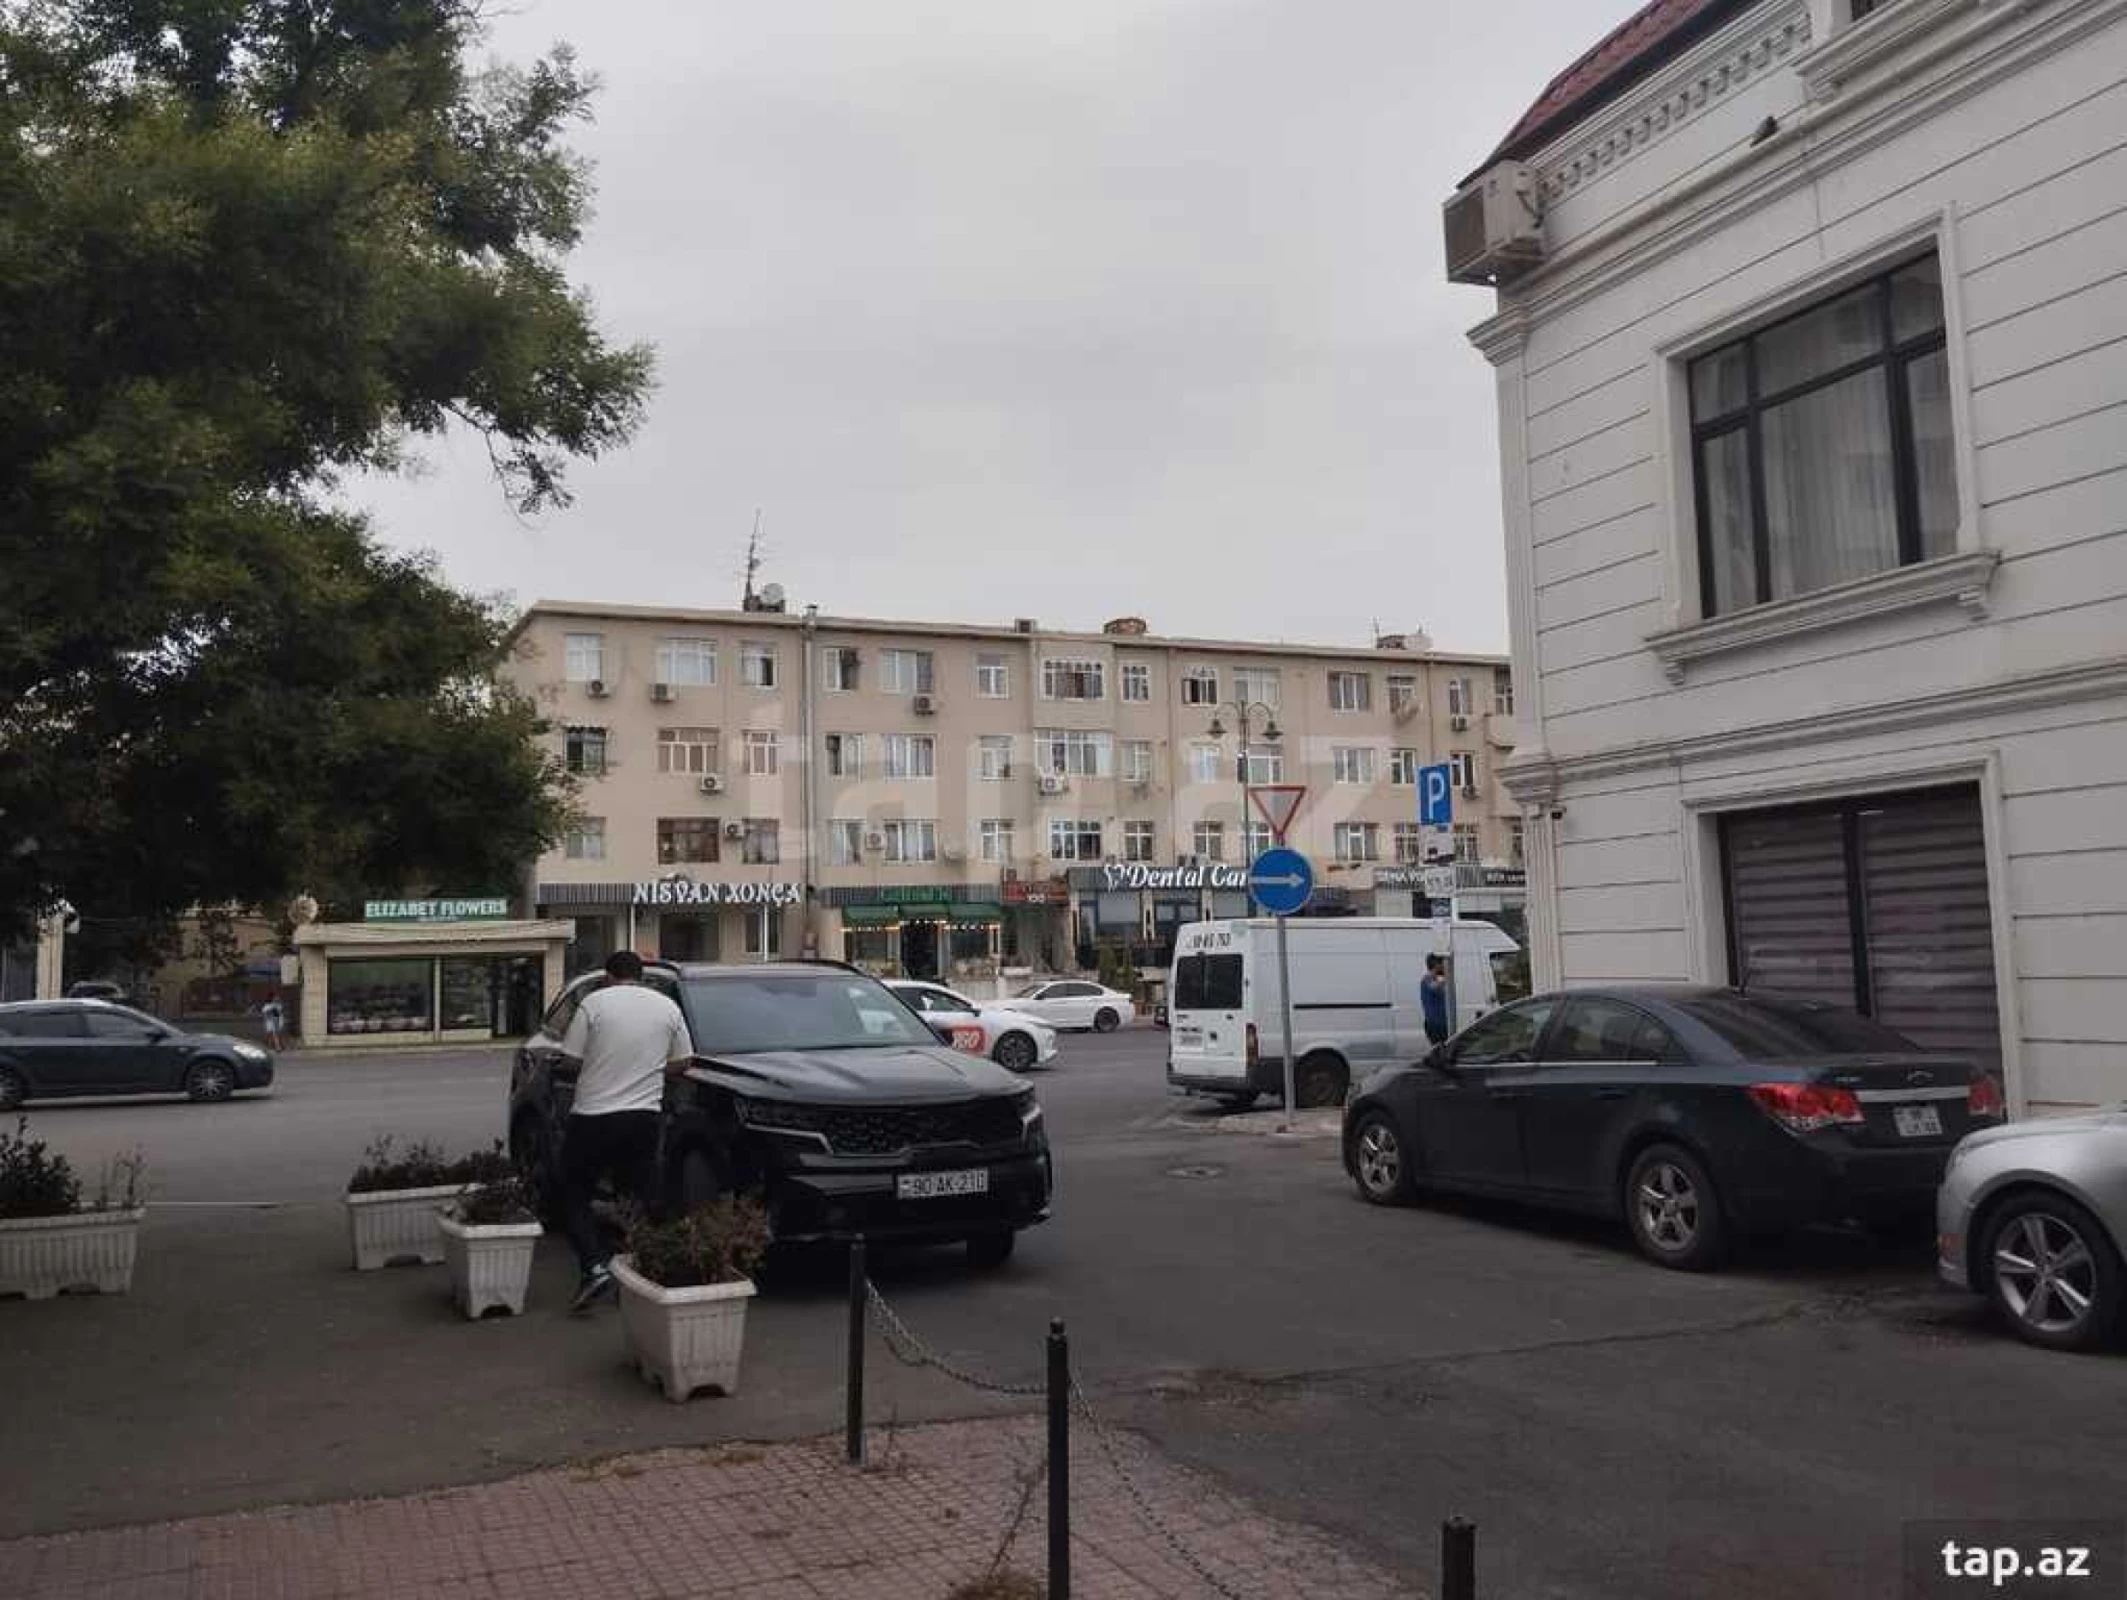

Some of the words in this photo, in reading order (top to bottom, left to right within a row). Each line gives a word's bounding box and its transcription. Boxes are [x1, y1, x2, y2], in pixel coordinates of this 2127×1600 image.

[1427, 772, 1445, 820] P
[1127, 864, 1204, 888] Dental
[440, 900, 507, 916] FLOWERS
